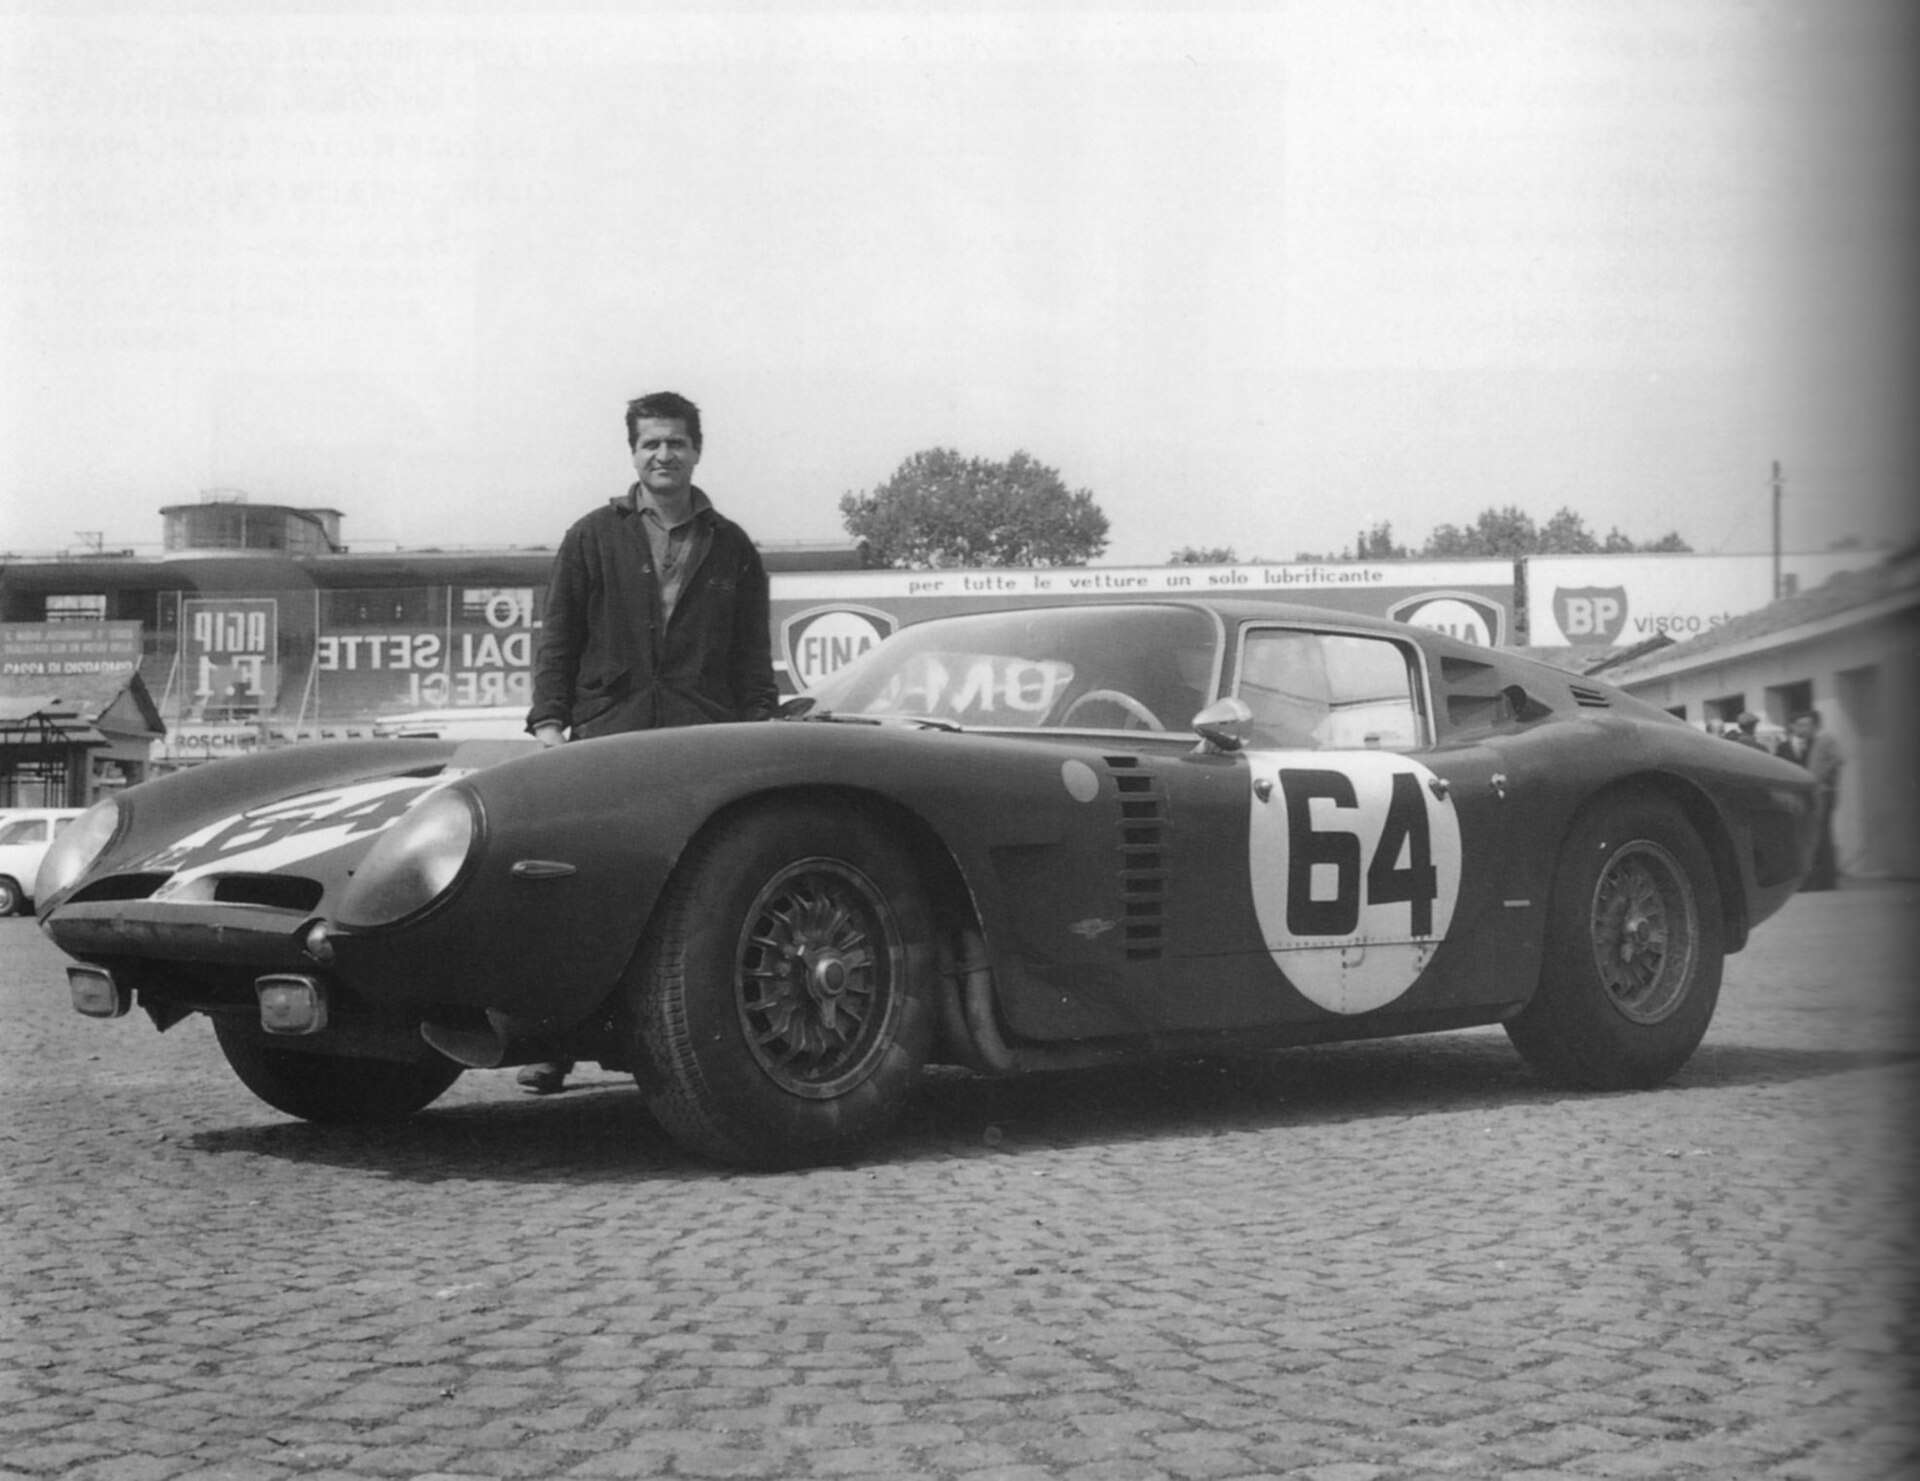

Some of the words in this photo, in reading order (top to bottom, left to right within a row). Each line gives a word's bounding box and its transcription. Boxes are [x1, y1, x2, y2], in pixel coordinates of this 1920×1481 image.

[909, 579, 944, 594] per
[963, 575, 1016, 590] tutte
[1034, 574, 1051, 589] le
[1069, 573, 1148, 588] vetture
[1166, 574, 1191, 586] un
[1208, 569, 1248, 584] solo
[1264, 566, 1382, 582] lubrificante
[1564, 597, 1620, 636] BP
[1633, 611, 1701, 633] visco
[1278, 767, 1437, 937] 64
